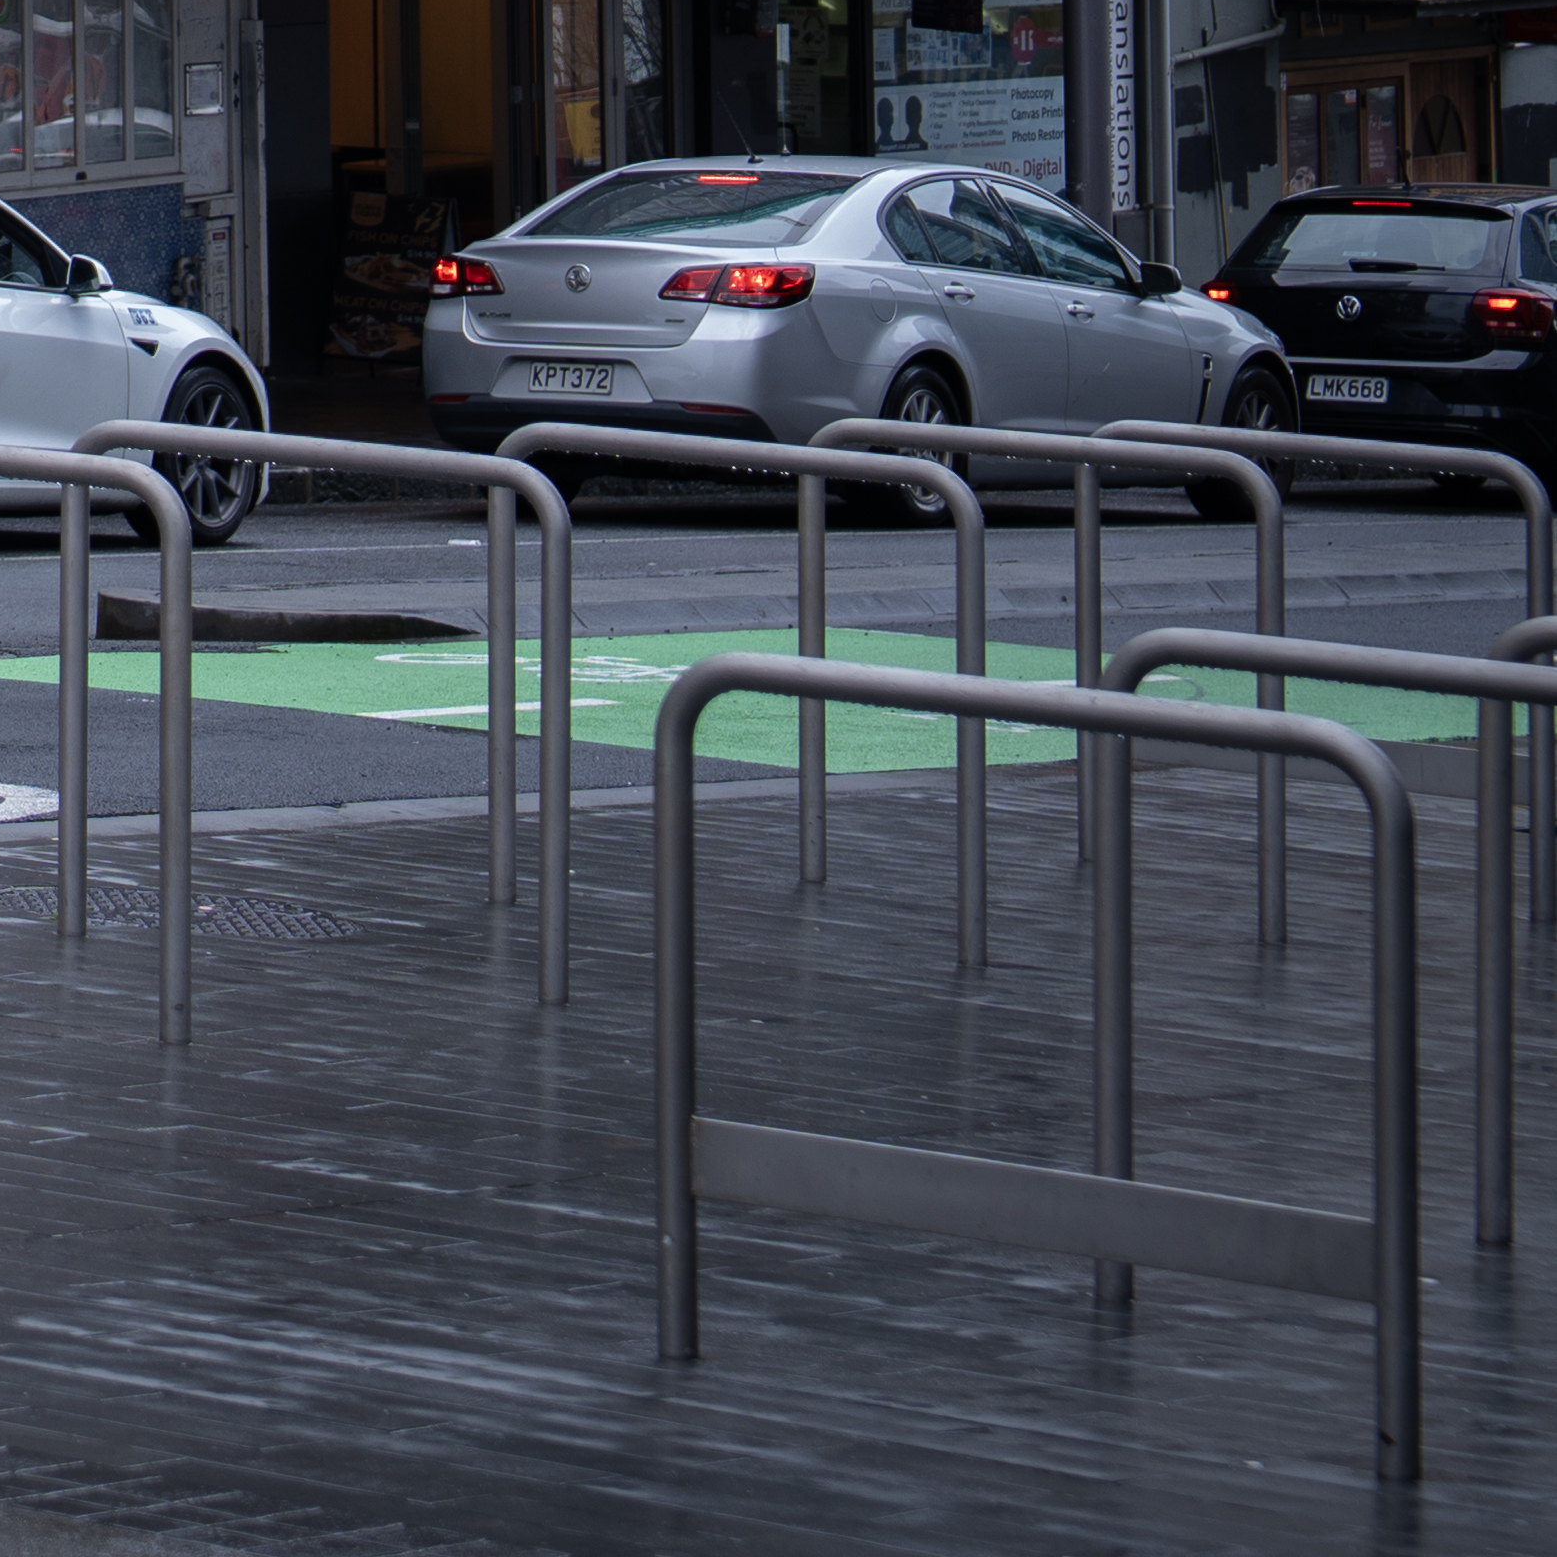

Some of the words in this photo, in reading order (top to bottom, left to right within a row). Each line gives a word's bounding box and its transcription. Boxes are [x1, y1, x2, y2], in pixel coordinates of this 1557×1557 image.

[1023, 157, 1063, 180] Digital
[531, 365, 611, 391] KPT372
[1309, 375, 1386, 400] LMK668
